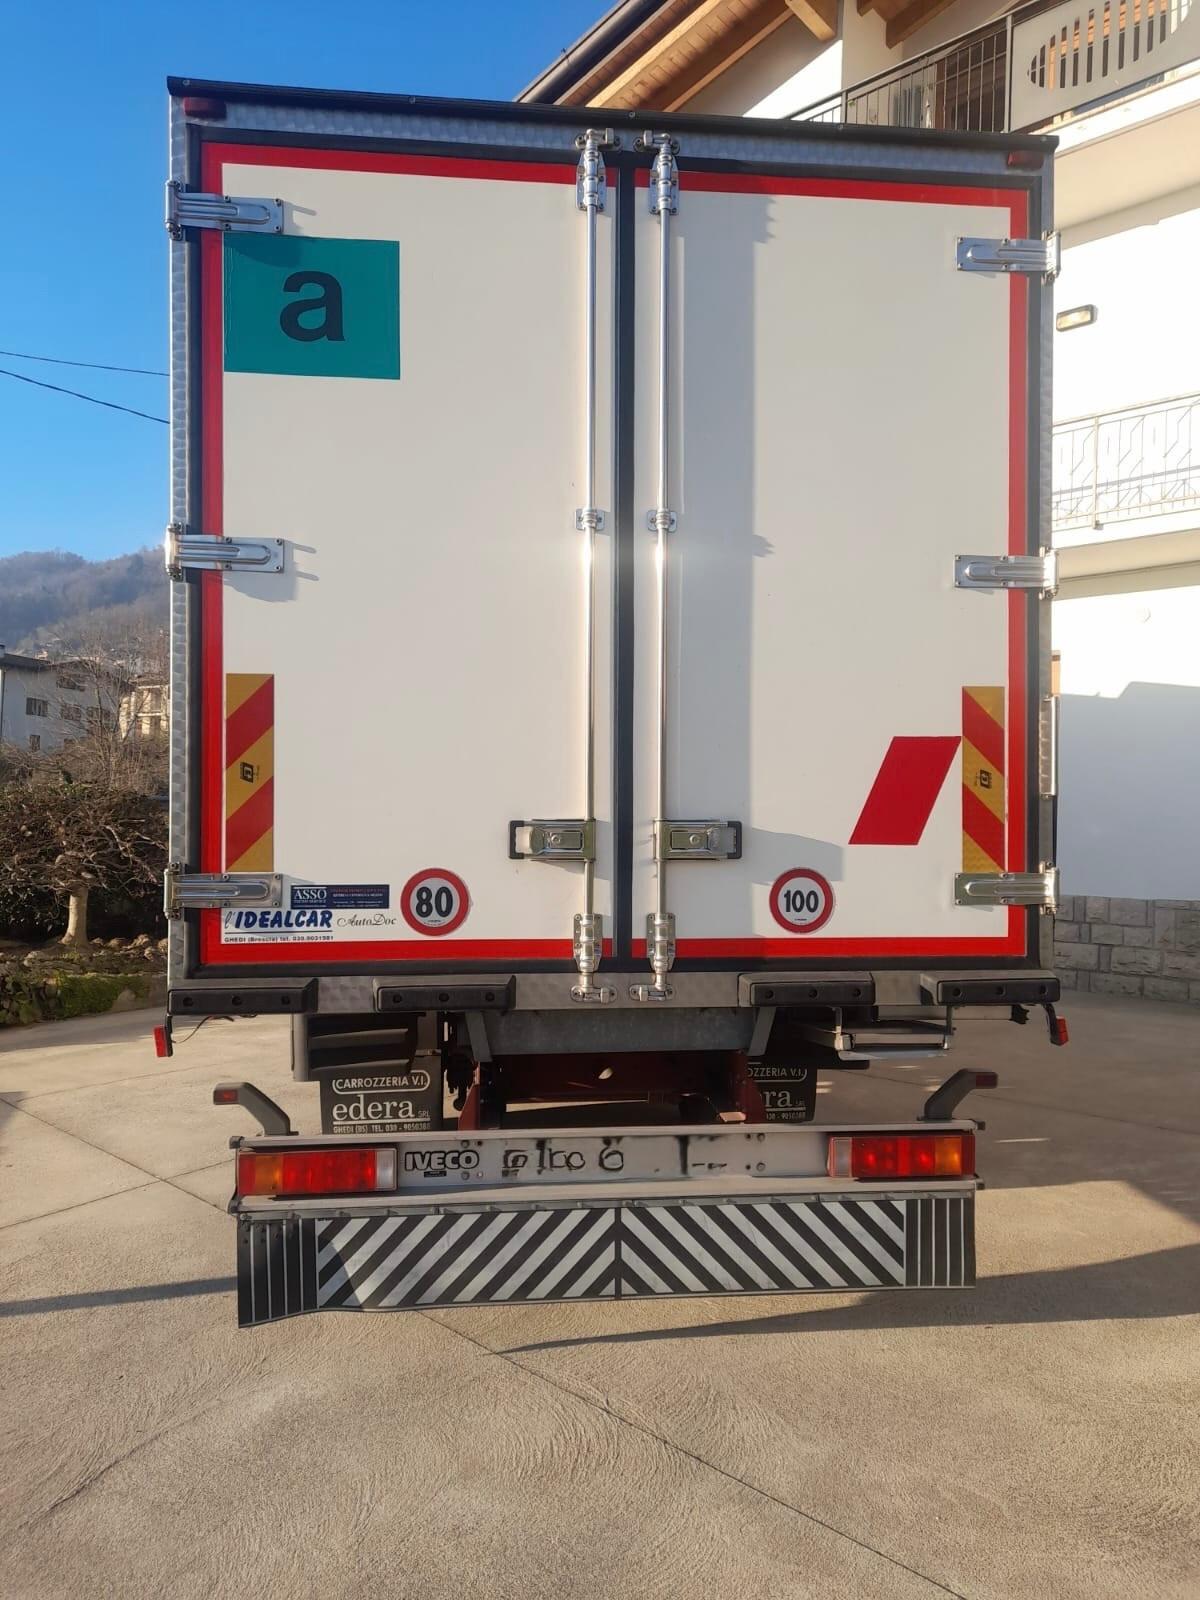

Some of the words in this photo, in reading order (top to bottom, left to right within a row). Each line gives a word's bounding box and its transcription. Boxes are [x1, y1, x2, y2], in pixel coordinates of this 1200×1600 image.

[279, 270, 345, 342] a
[294, 889, 327, 900] ASSO
[416, 886, 453, 918] 80
[783, 890, 819, 913] 100
[335, 1076, 409, 1090] CARROZZERIA
[412, 1075, 427, 1086] V.I.
[748, 1067, 788, 1078] OZZERIA
[332, 1094, 415, 1121] edera
[333, 1125, 354, 1134] GHEDI
[405, 1149, 480, 1171] IVECO
